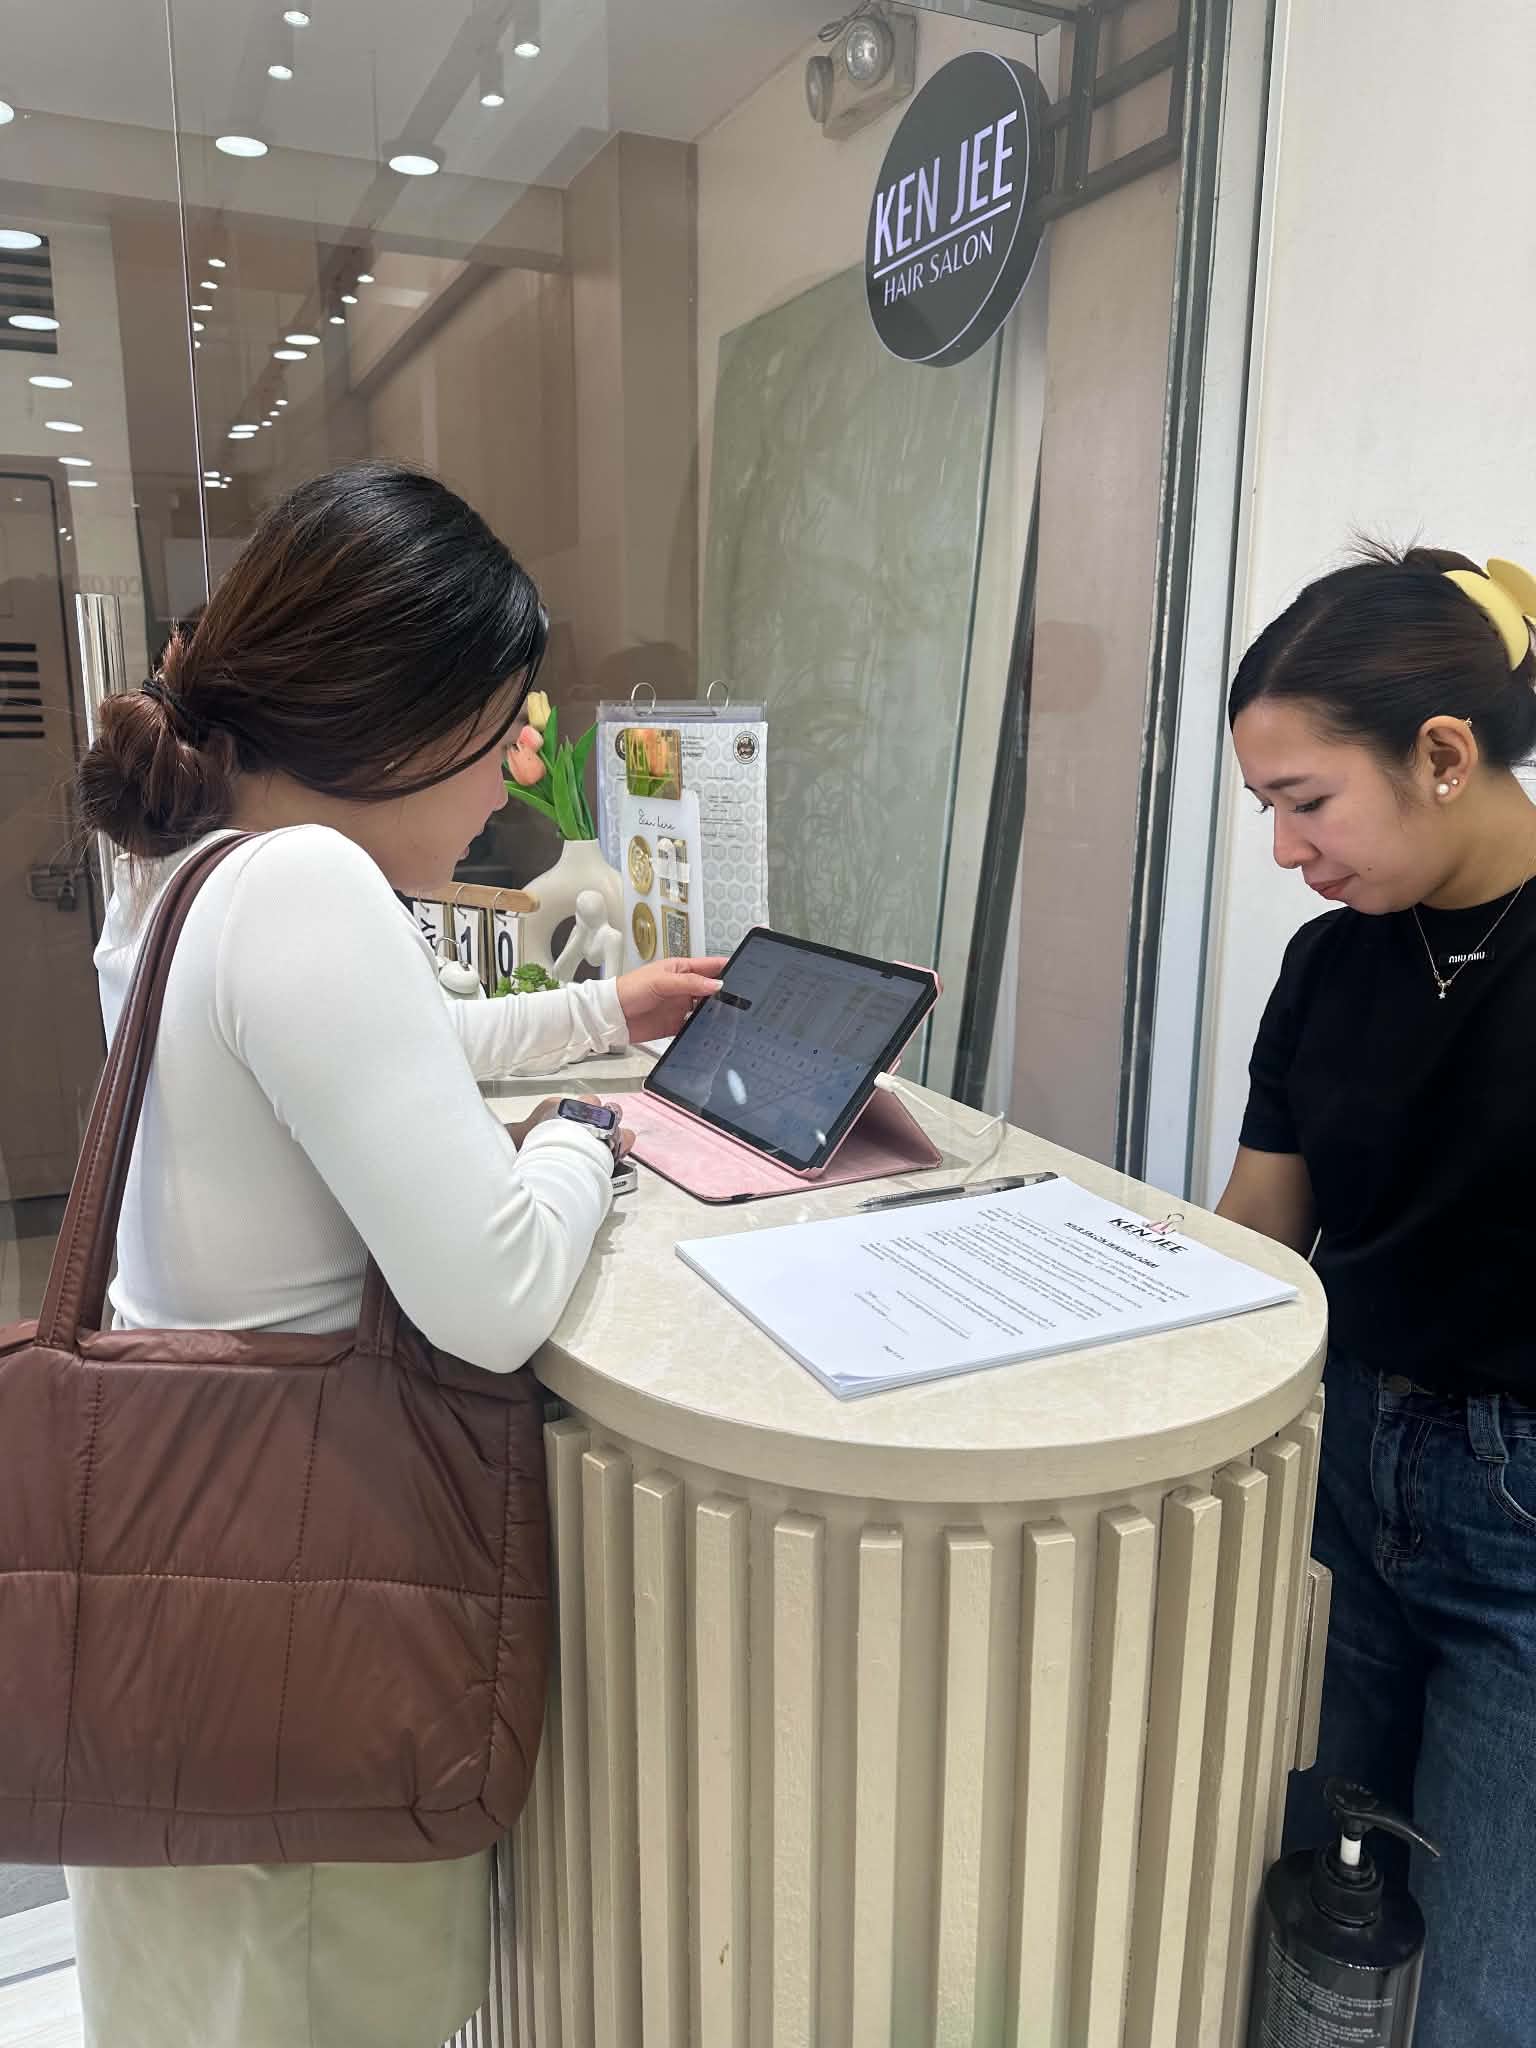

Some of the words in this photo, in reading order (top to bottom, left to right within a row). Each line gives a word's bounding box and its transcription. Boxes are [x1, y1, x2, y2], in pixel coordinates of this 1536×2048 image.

[873, 157, 941, 266] KEN
[950, 109, 1017, 225] JEE
[884, 263, 925, 308] HAIR
[930, 226, 994, 284] SALON
[1108, 1218, 1152, 1237] KEN
[1149, 1238, 1189, 1254] JEE
